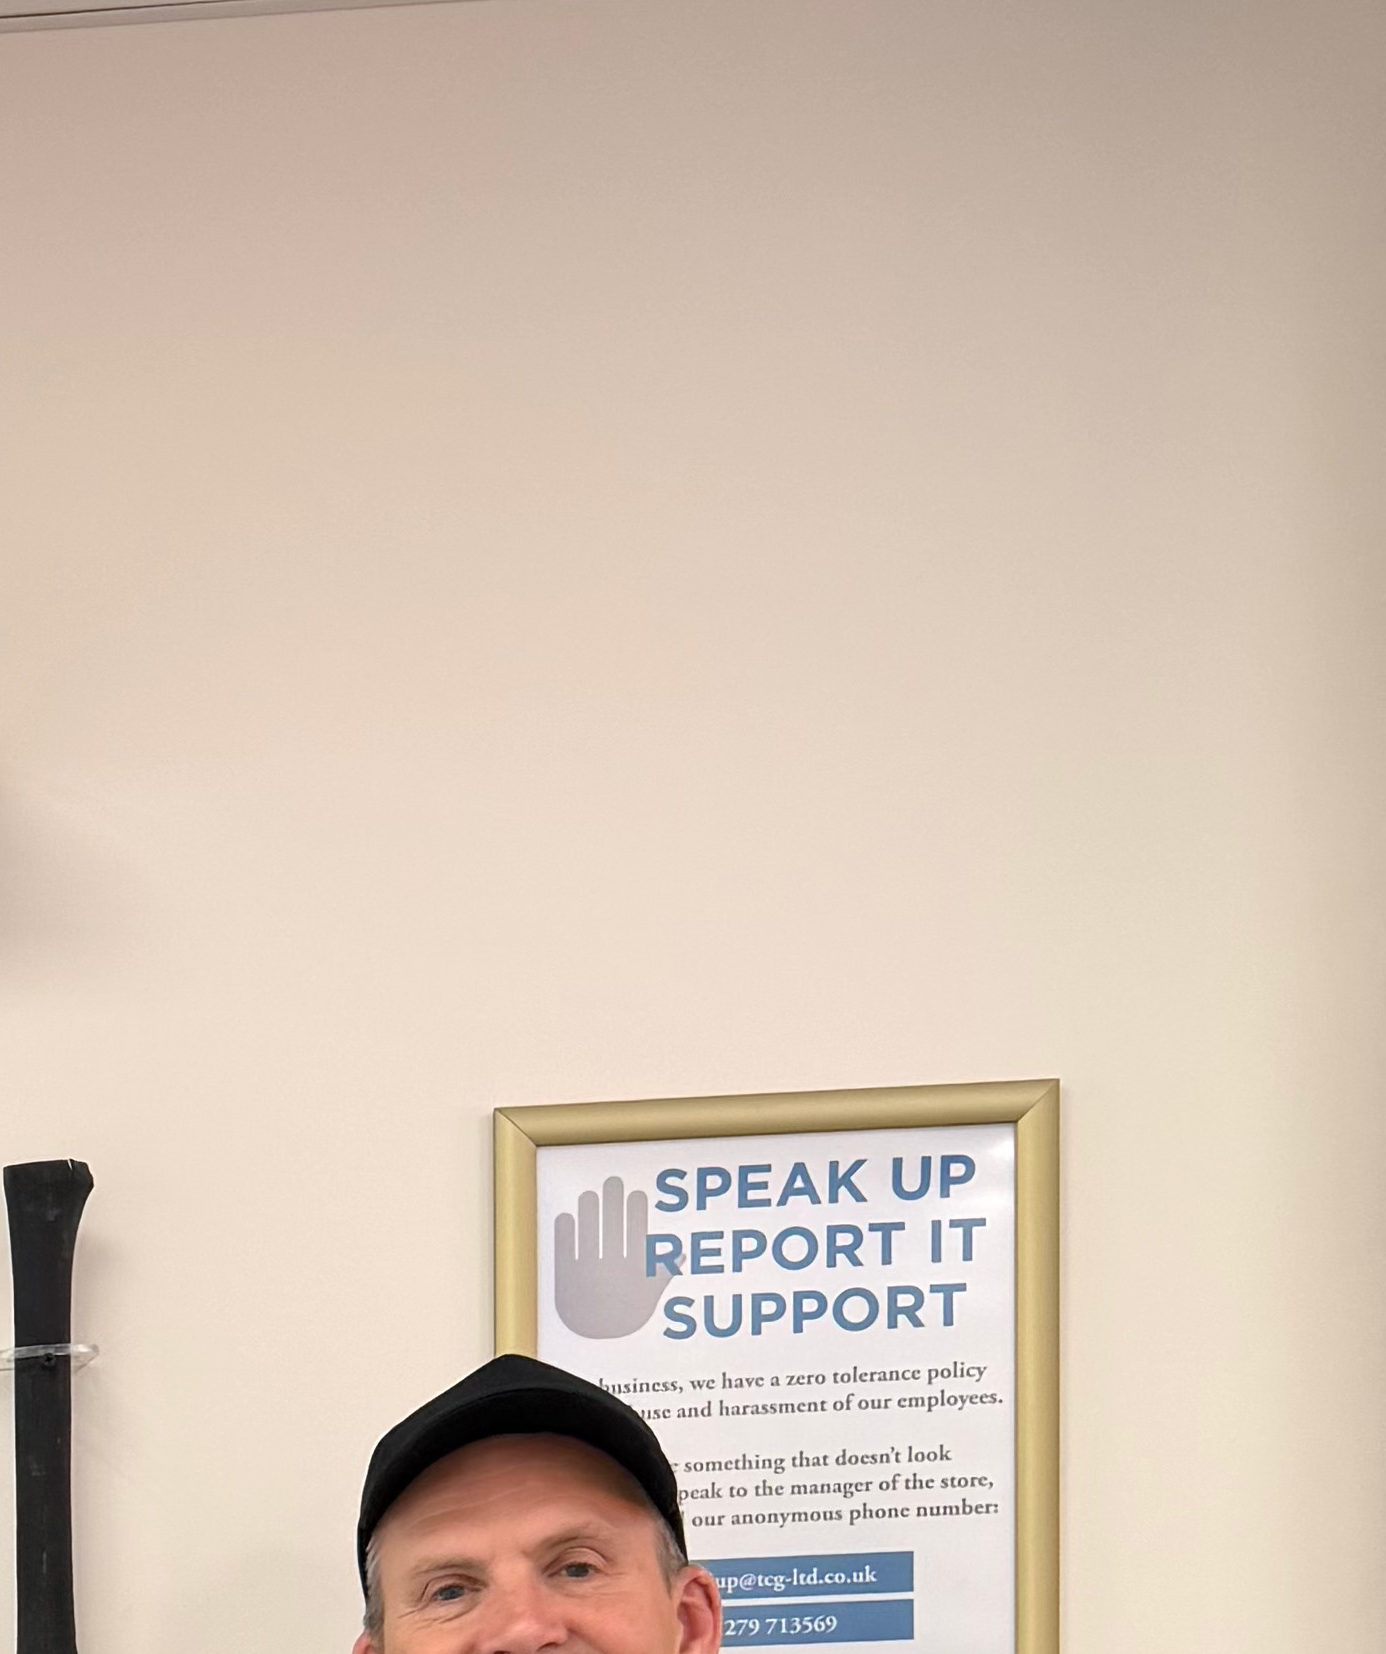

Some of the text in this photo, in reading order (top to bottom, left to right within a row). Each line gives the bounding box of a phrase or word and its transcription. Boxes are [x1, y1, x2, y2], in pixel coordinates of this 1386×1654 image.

[654, 1154, 975, 1212] SPEAK UP
[645, 1217, 986, 1278] REPORT IT
[663, 1282, 966, 1340] SUPPORT
[689, 1379, 715, 1389] we
[721, 1371, 764, 1389] have
[770, 1375, 780, 1386] a
[786, 1373, 825, 1385] zero
[832, 1365, 920, 1384] tolerance
[927, 1360, 986, 1385] policy
[640, 1388, 1003, 1420] use and harassment of our employees.
[683, 1453, 785, 1474] something
[791, 1450, 828, 1467] that
[835, 1446, 900, 1466] doesn't
[907, 1444, 951, 1462] look
[678, 1472, 993, 1506] peak to the manager of the store,
[691, 1515, 725, 1526] our
[731, 1509, 842, 1528] anonymous
[849, 1502, 909, 1526] phone
[916, 1497, 998, 1517] number:
[715, 1565, 876, 1593] up@tcg-ltd.co.uk
[724, 1615, 837, 1635] 279 713569
